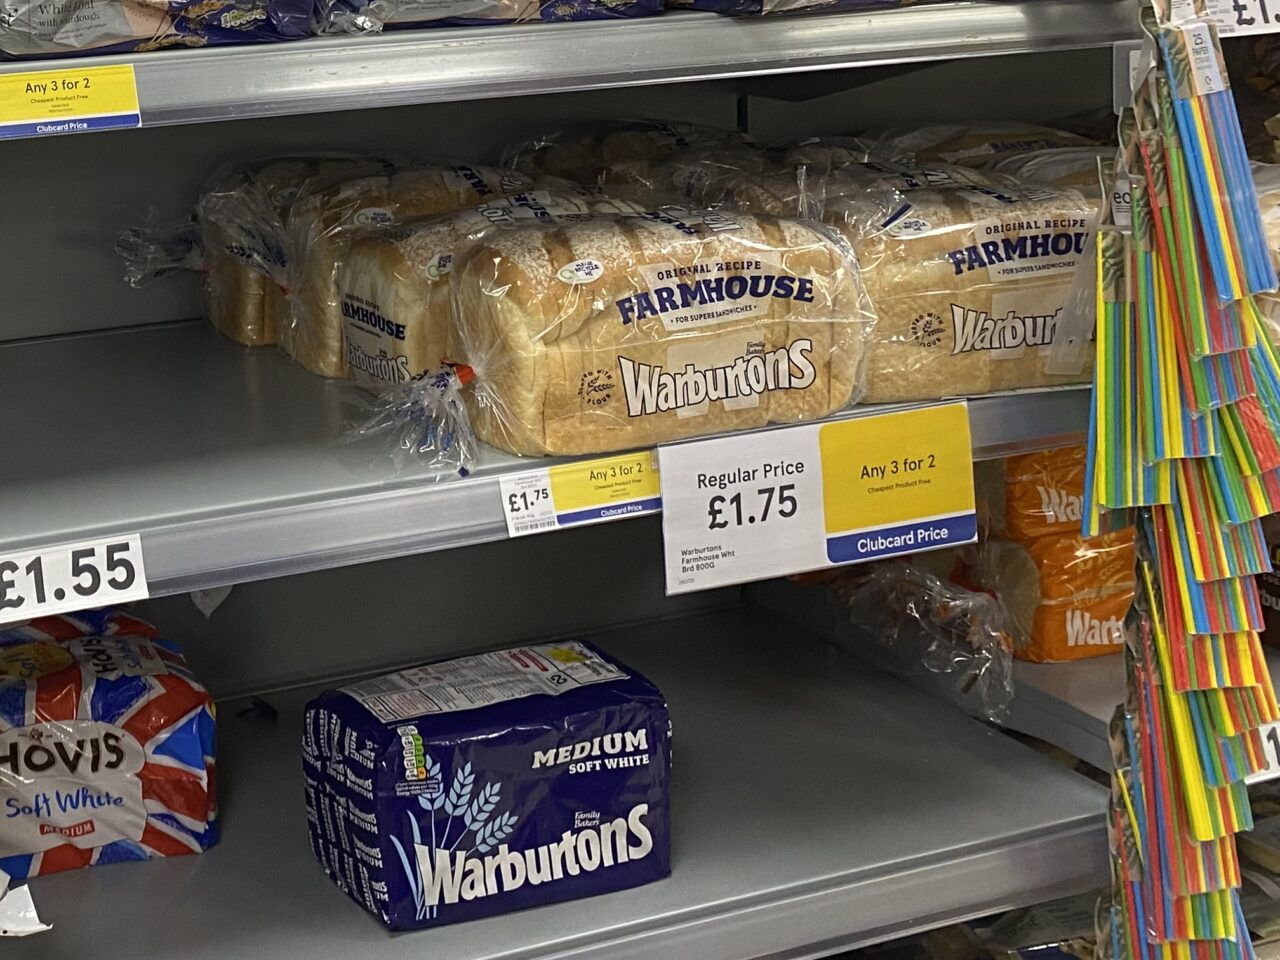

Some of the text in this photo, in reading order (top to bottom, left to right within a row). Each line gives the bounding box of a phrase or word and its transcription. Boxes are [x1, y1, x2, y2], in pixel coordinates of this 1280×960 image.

[25, 78, 91, 94] Any 3 for 2
[30, 97, 54, 105] Cheapest
[37, 122, 87, 133] Clubcard Price
[986, 219, 1086, 235] ORIGINAL RECIPE
[657, 261, 762, 281] ORIGINAL RECIPE
[616, 275, 815, 325] FARMHOUSE
[690, 312, 715, 322] SUPERB
[715, 305, 752, 318] SANDWICHES
[618, 338, 816, 418] Warburtons
[589, 463, 643, 481] Any 3 for 2
[697, 460, 805, 490] Regular Price
[860, 455, 936, 480] Any 3 for 2
[867, 478, 931, 494] Cheapest Product Free
[509, 489, 548, 512] £1.75
[708, 484, 797, 530] £1.75
[601, 505, 643, 517] Clubcard Price
[858, 526, 949, 553] Clubcard Price
[681, 544, 722, 556] Warburtons
[681, 550, 735, 565] Farmhouse Wht
[682, 562, 715, 574] Brd 800G
[532, 729, 647, 769] MEDIUM
[569, 754, 649, 774] SOFT WHITE
[6, 786, 124, 818] Soft White
[575, 811, 600, 820] Family
[414, 803, 653, 906] Warburtons
